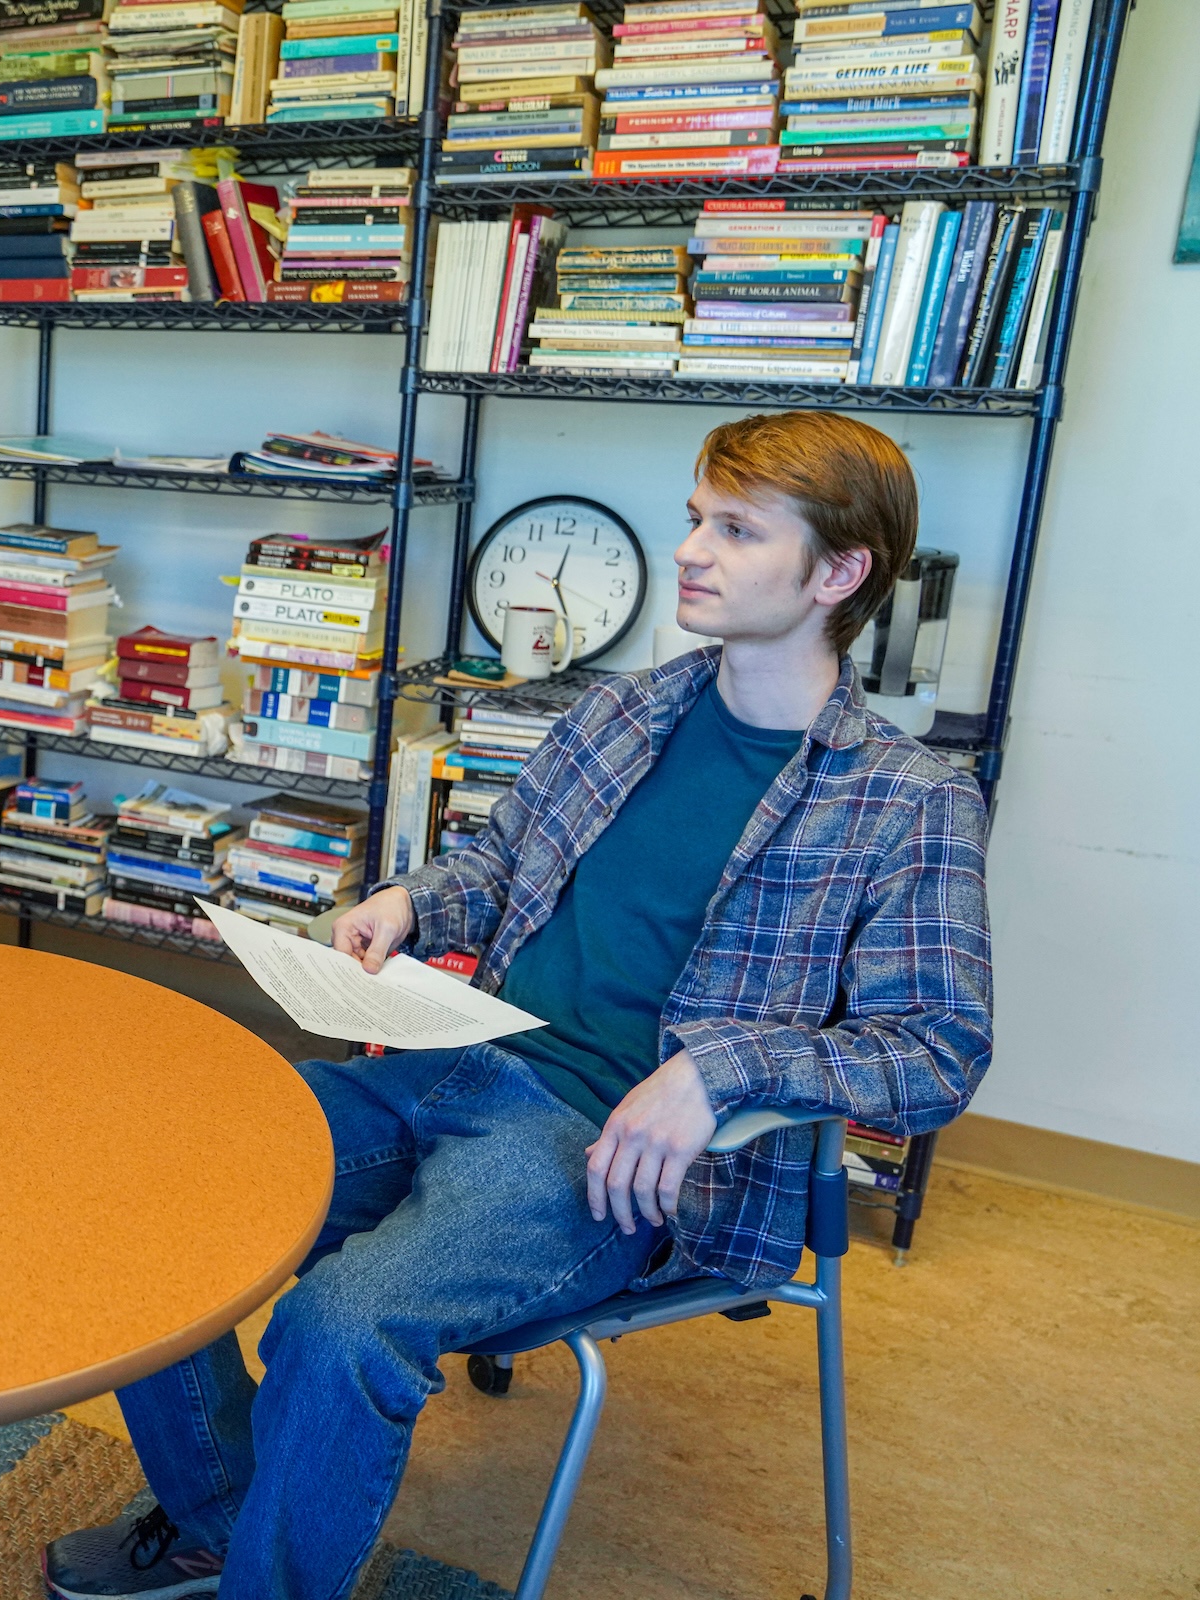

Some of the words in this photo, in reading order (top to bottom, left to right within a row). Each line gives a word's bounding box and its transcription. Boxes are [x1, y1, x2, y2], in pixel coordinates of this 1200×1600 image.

[847, 22, 883, 30] LIBERTY
[1004, 0, 1020, 39] HARP
[870, 50, 895, 58] dare
[908, 46, 933, 56] lead
[610, 72, 634, 80] LEAN
[635, 71, 645, 79] IN
[653, 69, 688, 79] SHERYL
[690, 66, 742, 77] SANDBERG
[836, 66, 886, 80] GETTING
[891, 64, 900, 76] A
[904, 62, 931, 75] LIFE
[942, 62, 965, 71] USED
[700, 86, 744, 95] Wilderness
[629, 118, 674, 126] FEMINISM
[686, 114, 746, 124] PHILOSOPHY
[792, 148, 812, 157] Listen
[814, 146, 824, 156] Up
[513, 162, 541, 172] MOON
[346, 198, 383, 206] PRINCE
[708, 202, 746, 211] CULTURAL
[747, 202, 785, 211] LITERACY
[958, 250, 975, 283] Walden
[352, 284, 378, 292] WALTER
[728, 286, 747, 296] THE
[749, 286, 782, 296] MORAL
[784, 286, 822, 296] ANIMAL
[858, 284, 871, 316] DYNAMIC
[698, 310, 708, 318] The
[710, 310, 753, 319] Interpretation
[761, 310, 787, 318] Cultures
[853, 316, 866, 349] LECTURING
[707, 363, 764, 374] Remembering
[767, 364, 813, 374] Esperanza
[528, 523, 543, 542] 11
[554, 516, 576, 536] 12
[592, 528, 599, 546] 1
[502, 544, 526, 563] 10
[605, 548, 621, 566] 2
[489, 570, 506, 589] 9
[280, 584, 334, 602] PLATO
[609, 579, 626, 599] 3
[275, 605, 324, 623] PLATO
[494, 600, 510, 618] 8
[594, 608, 612, 627] 4
[573, 626, 586, 647] 5
[278, 736, 321, 749] VOICES
[446, 958, 464, 971] EYE
